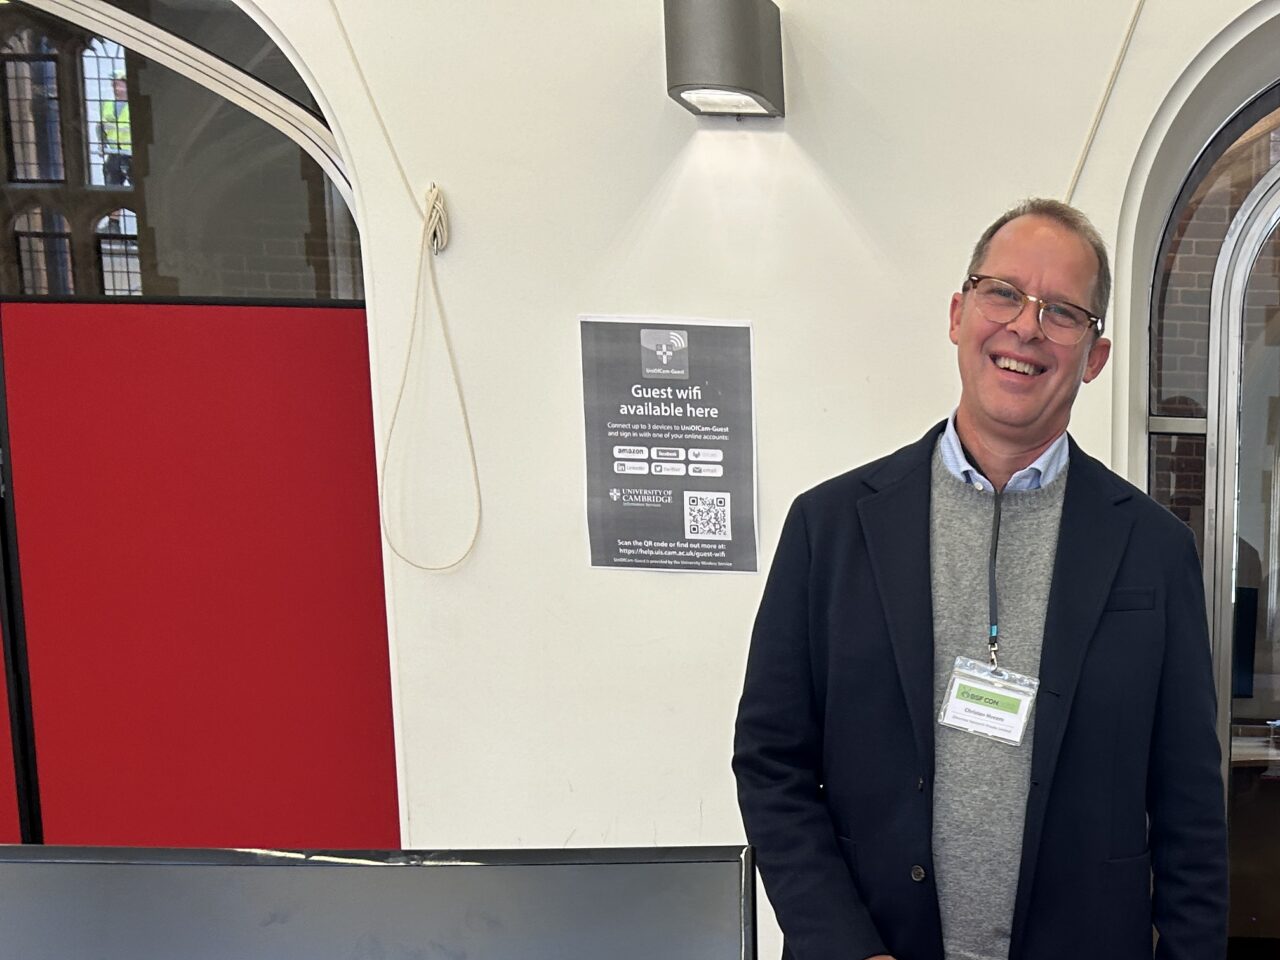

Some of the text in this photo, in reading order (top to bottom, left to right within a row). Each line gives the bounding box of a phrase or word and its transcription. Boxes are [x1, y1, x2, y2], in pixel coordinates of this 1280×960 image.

[631, 384, 701, 400] Guest wifi
[620, 402, 719, 417] available here
[623, 495, 672, 503] CAMBRIDGE
